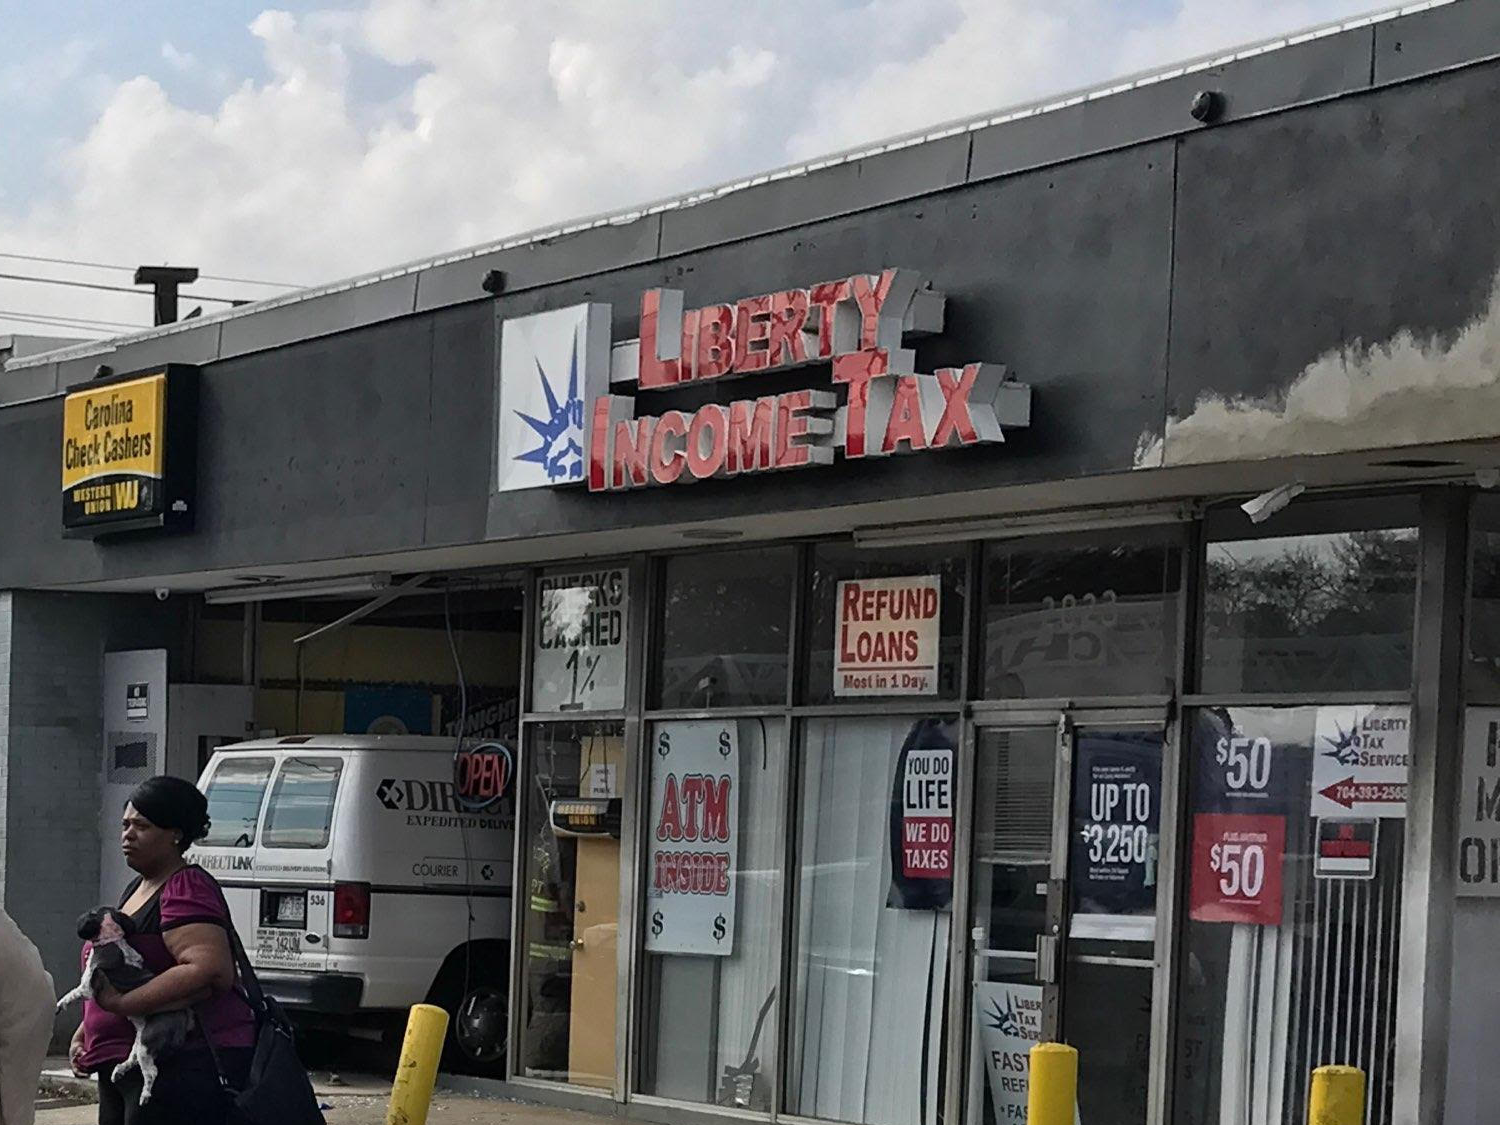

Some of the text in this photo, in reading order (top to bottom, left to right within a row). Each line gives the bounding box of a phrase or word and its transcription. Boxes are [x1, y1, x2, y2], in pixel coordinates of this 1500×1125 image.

[639, 267, 898, 389] LIBERTY
[85, 394, 133, 431] Carolina
[588, 348, 982, 491] INCOME TAX
[66, 428, 151, 470] Check Cashers
[73, 484, 112, 502] WESTERN
[85, 498, 112, 515] UNION
[842, 583, 938, 621] REFUND
[841, 624, 918, 663] LOANS
[843, 674, 873, 689] Most
[876, 673, 887, 688] in
[890, 674, 899, 688] 1
[1362, 717, 1407, 731] LIBERTY
[1362, 734, 1385, 749] TAX
[908, 757, 949, 775] YOU DO
[1215, 736, 1272, 789] $50
[1360, 752, 1409, 766] SERVICE
[458, 752, 507, 797] OPEN
[906, 780, 948, 809] LIFE
[1091, 783, 1150, 822] UP TO
[656, 773, 731, 842] ATM
[406, 815, 477, 829] EXPEDITED
[905, 823, 950, 843] WE DO
[1082, 824, 1148, 864] $3,250
[905, 849, 948, 869] TAXES
[412, 863, 459, 877] COURIER
[655, 851, 731, 895] INSIDE
[1210, 844, 1265, 897] $50
[310, 895, 325, 906] 536
[1014, 995, 1043, 1010] LIBER
[1017, 1011, 1037, 1026] TAX
[1020, 1025, 1041, 1040] SER
